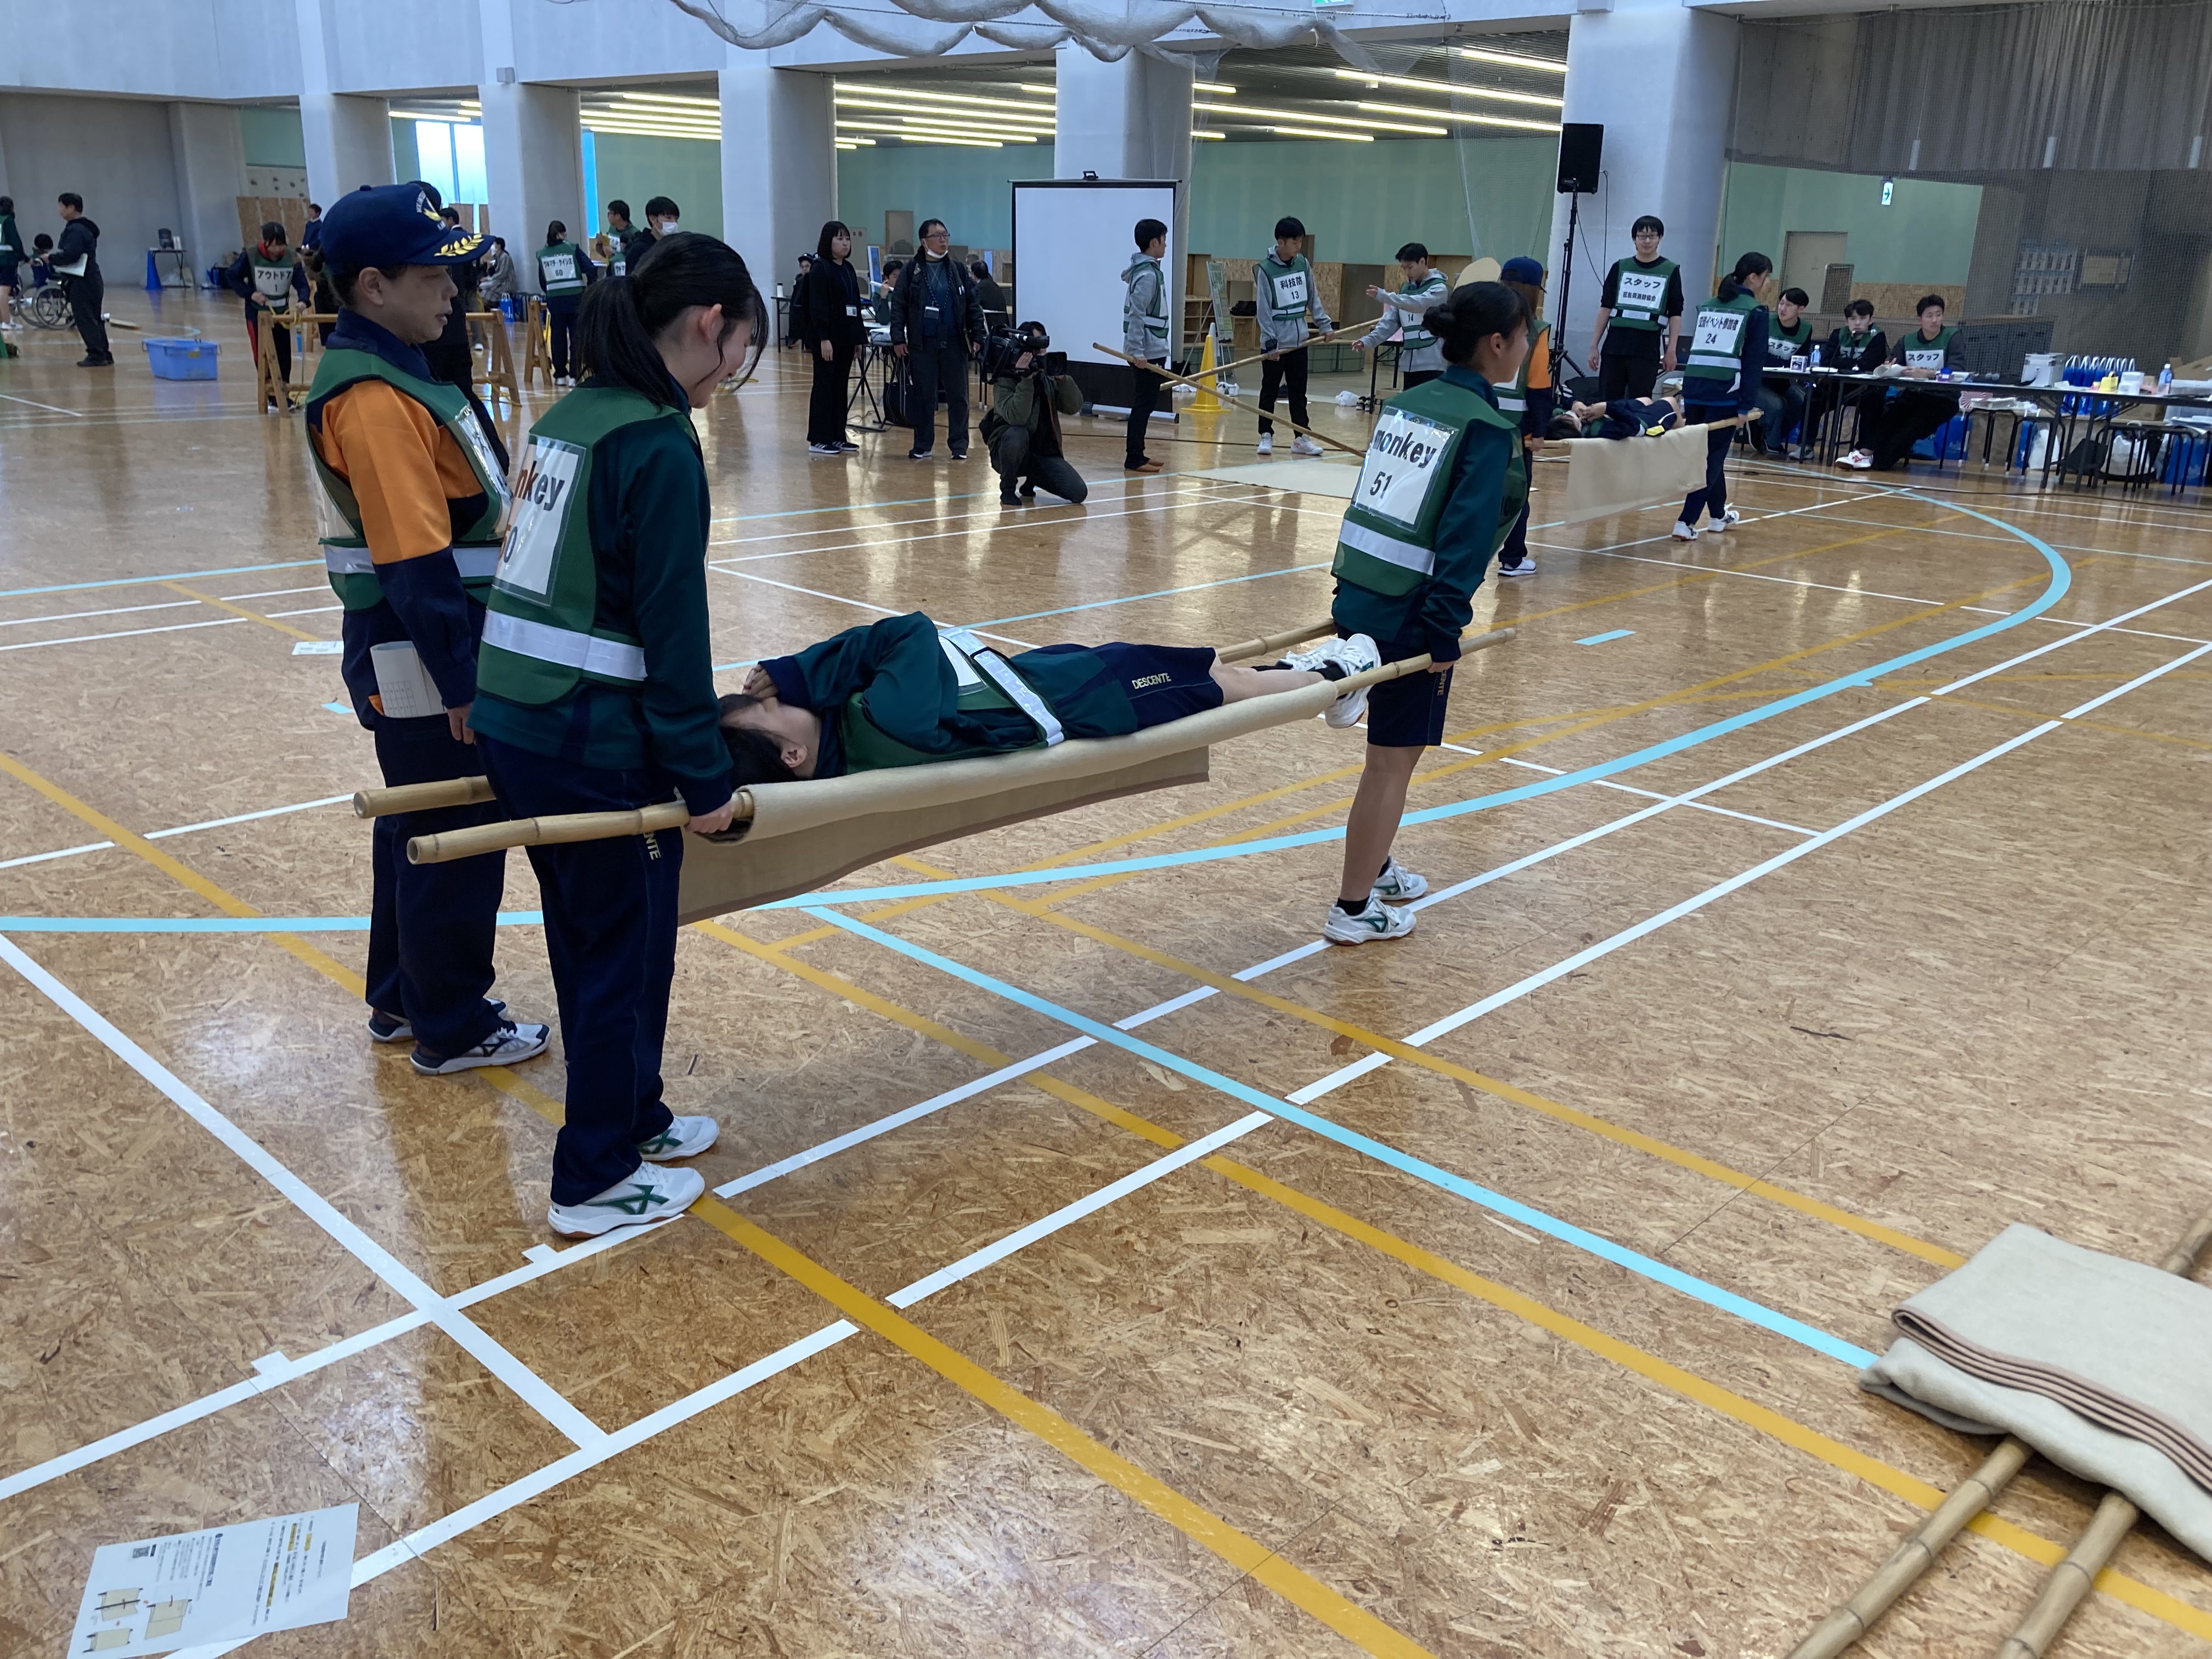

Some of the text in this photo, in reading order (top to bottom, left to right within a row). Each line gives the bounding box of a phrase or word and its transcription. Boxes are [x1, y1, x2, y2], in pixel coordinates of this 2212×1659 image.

[257, 270, 292, 280] アウトドア
[1280, 275, 1303, 290] 科技防
[1624, 278, 1661, 289] スタッフ
[1291, 291, 1299, 300] 13
[1706, 333, 1717, 344] 24
[1908, 353, 1939, 362] スタッフ
[1372, 430, 1437, 469] monkey
[1370, 471, 1392, 499] 51
[1131, 673, 1172, 690] DESCENTE
